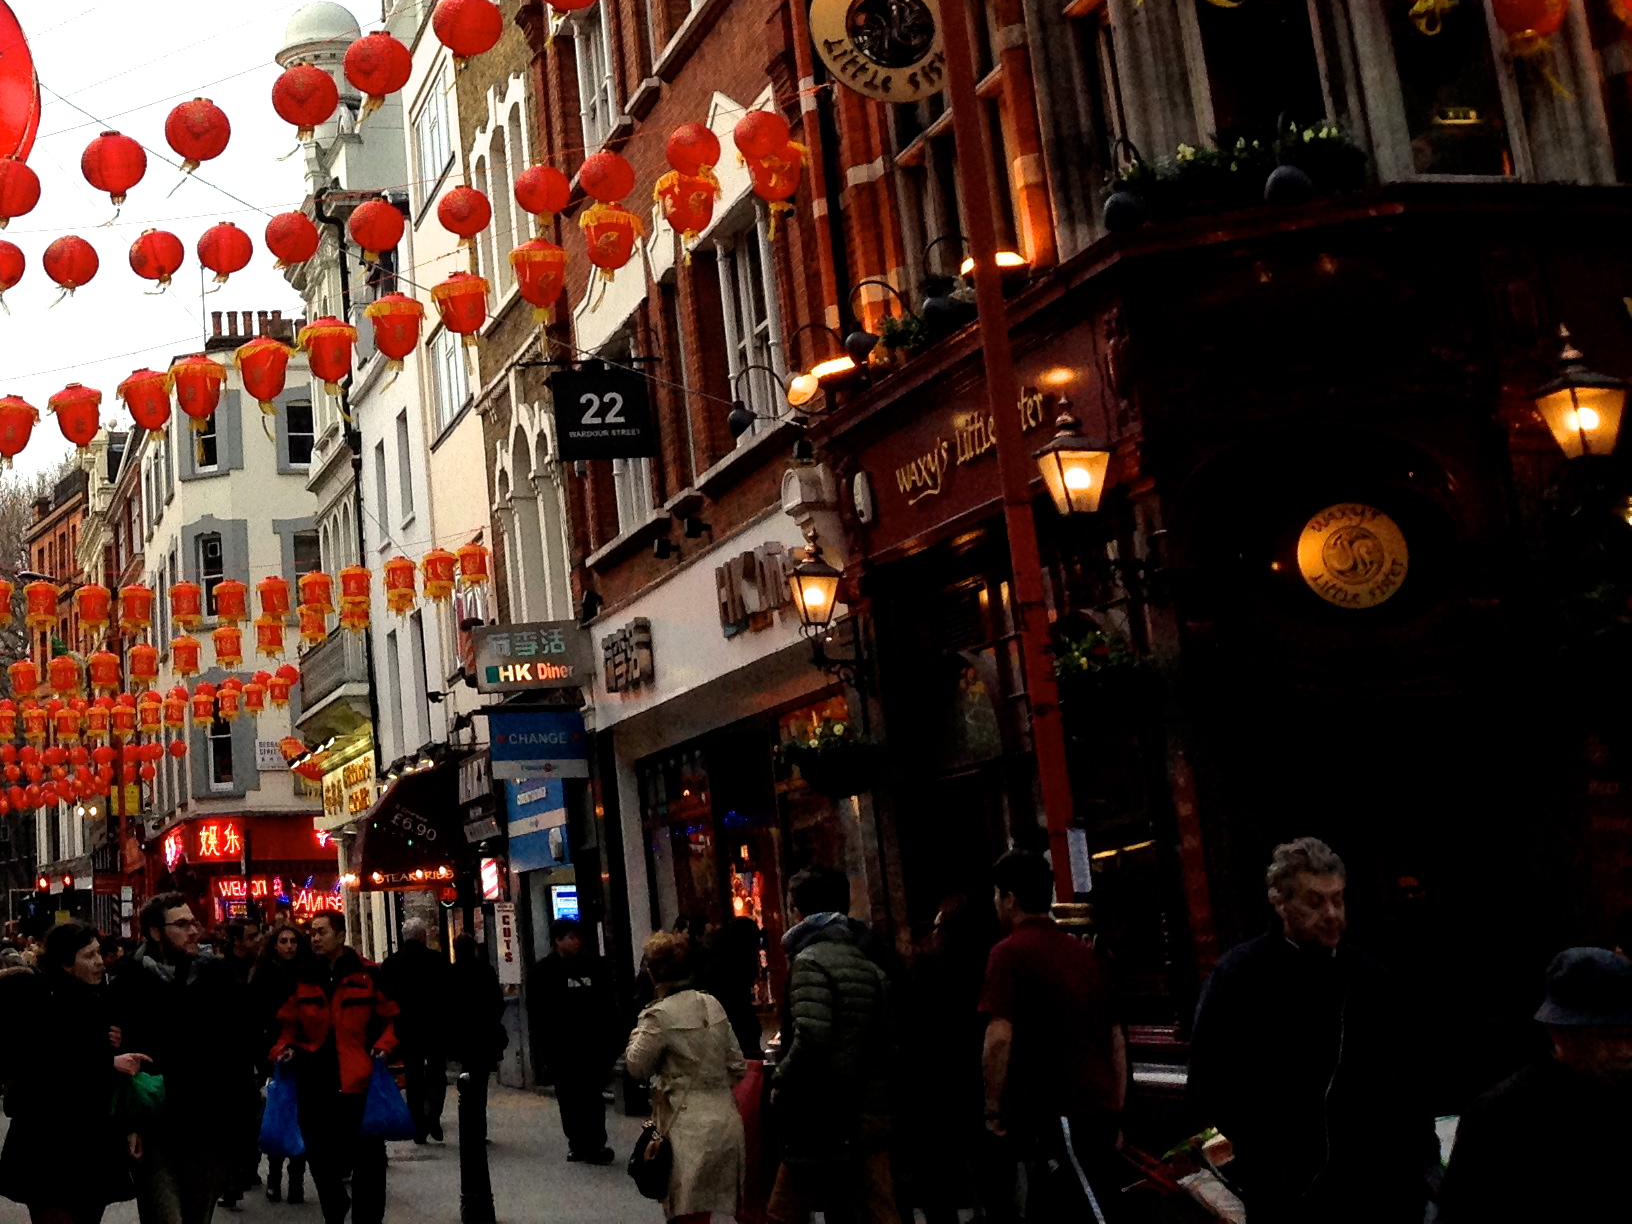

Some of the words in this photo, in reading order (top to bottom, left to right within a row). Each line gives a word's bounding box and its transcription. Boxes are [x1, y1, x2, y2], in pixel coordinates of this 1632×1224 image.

[580, 391, 626, 425] 22
[611, 428, 640, 436] STREET
[499, 663, 534, 682] HK
[537, 662, 575, 680] Diner
[508, 733, 567, 745] CHANGE
[390, 812, 437, 841] £6.90
[295, 889, 344, 913] AMUSE
[501, 915, 514, 963] CUTS
